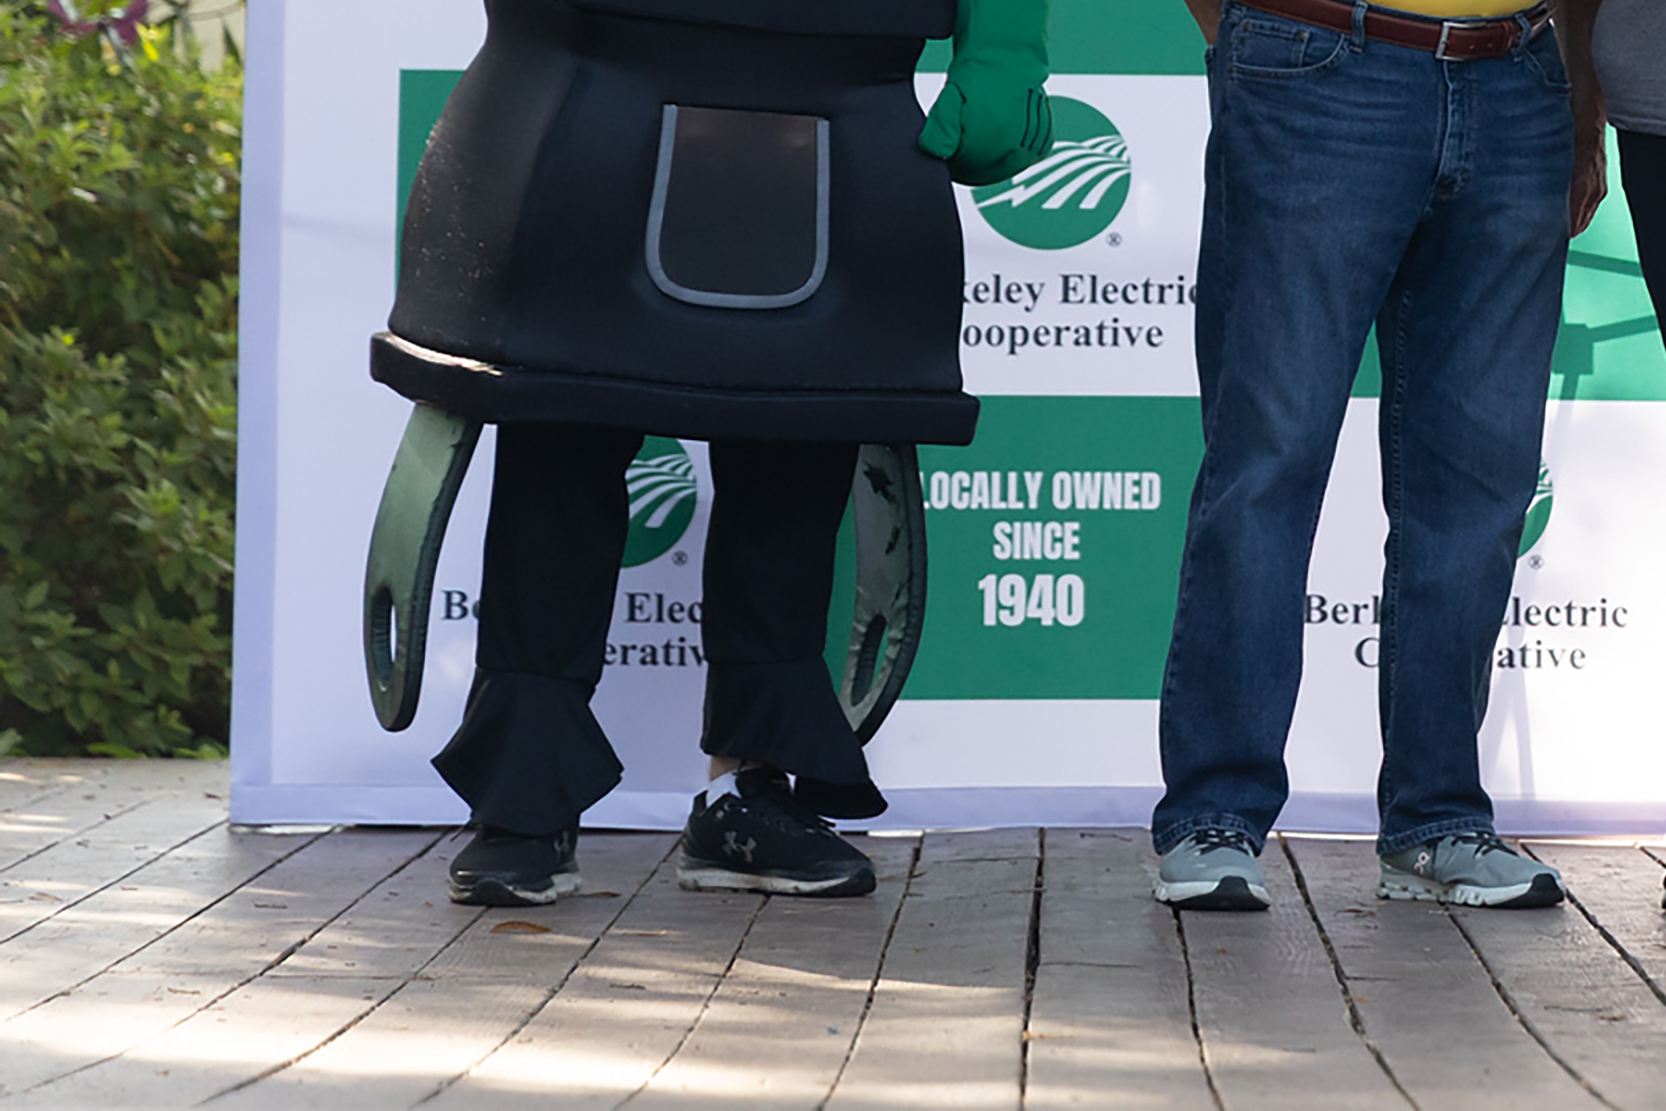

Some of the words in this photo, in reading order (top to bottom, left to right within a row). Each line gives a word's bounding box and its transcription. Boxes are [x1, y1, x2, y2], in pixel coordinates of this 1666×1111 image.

[1052, 471, 1162, 510] OWNED
[992, 521, 1081, 560] SINCE
[978, 574, 1085, 626] 1940
[1502, 596, 1628, 628] lectric
